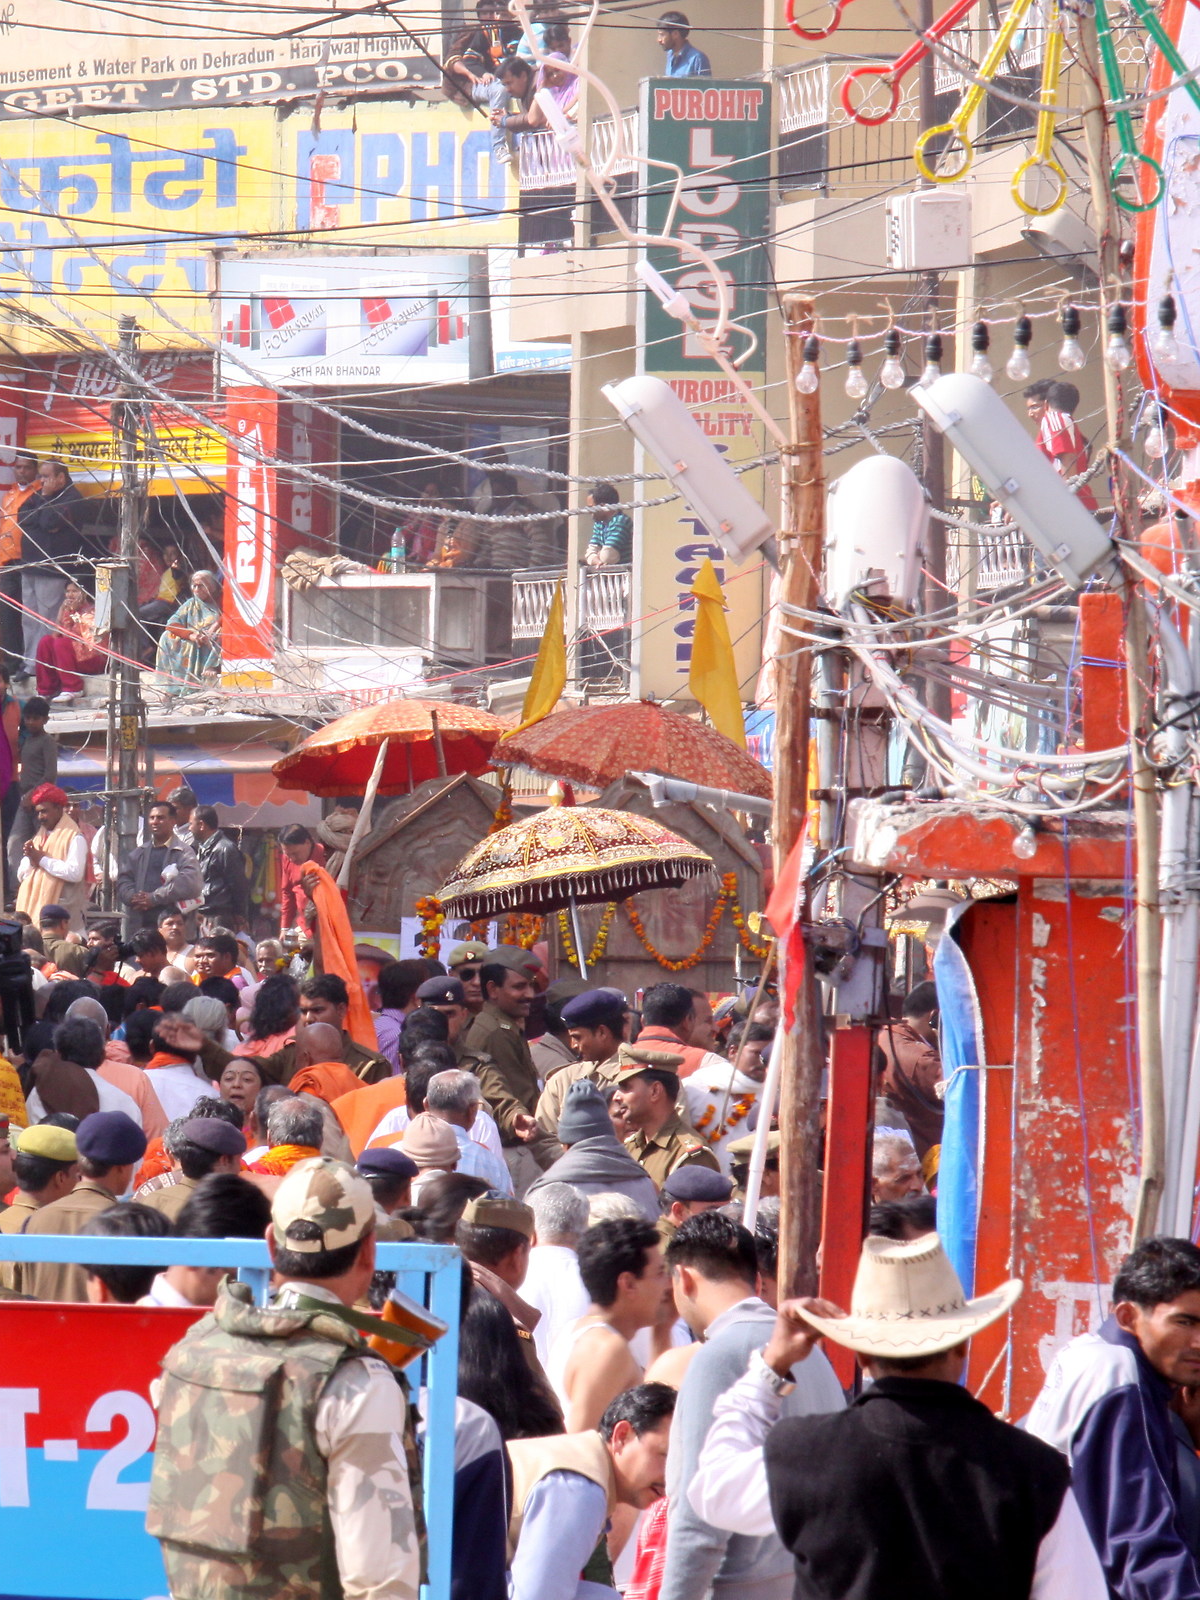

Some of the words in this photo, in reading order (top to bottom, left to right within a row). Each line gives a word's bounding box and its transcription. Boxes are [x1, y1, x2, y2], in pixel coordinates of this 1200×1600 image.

[78, 61, 88, 77] &
[93, 59, 137, 76] Water
[141, 56, 175, 74] Park
[180, 57, 197, 70] on
[203, 47, 275, 70] Dehradun
[290, 40, 359, 60] Hariwar
[364, 36, 430, 57] Highway
[3, 83, 147, 113] GEET
[191, 71, 297, 101] STD.
[654, 88, 763, 121] PUROHIT
[675, 127, 741, 359] LODGE
[291, 366, 312, 377] SETH
[315, 366, 333, 376] PAN
[336, 366, 381, 376] BHANDAR
